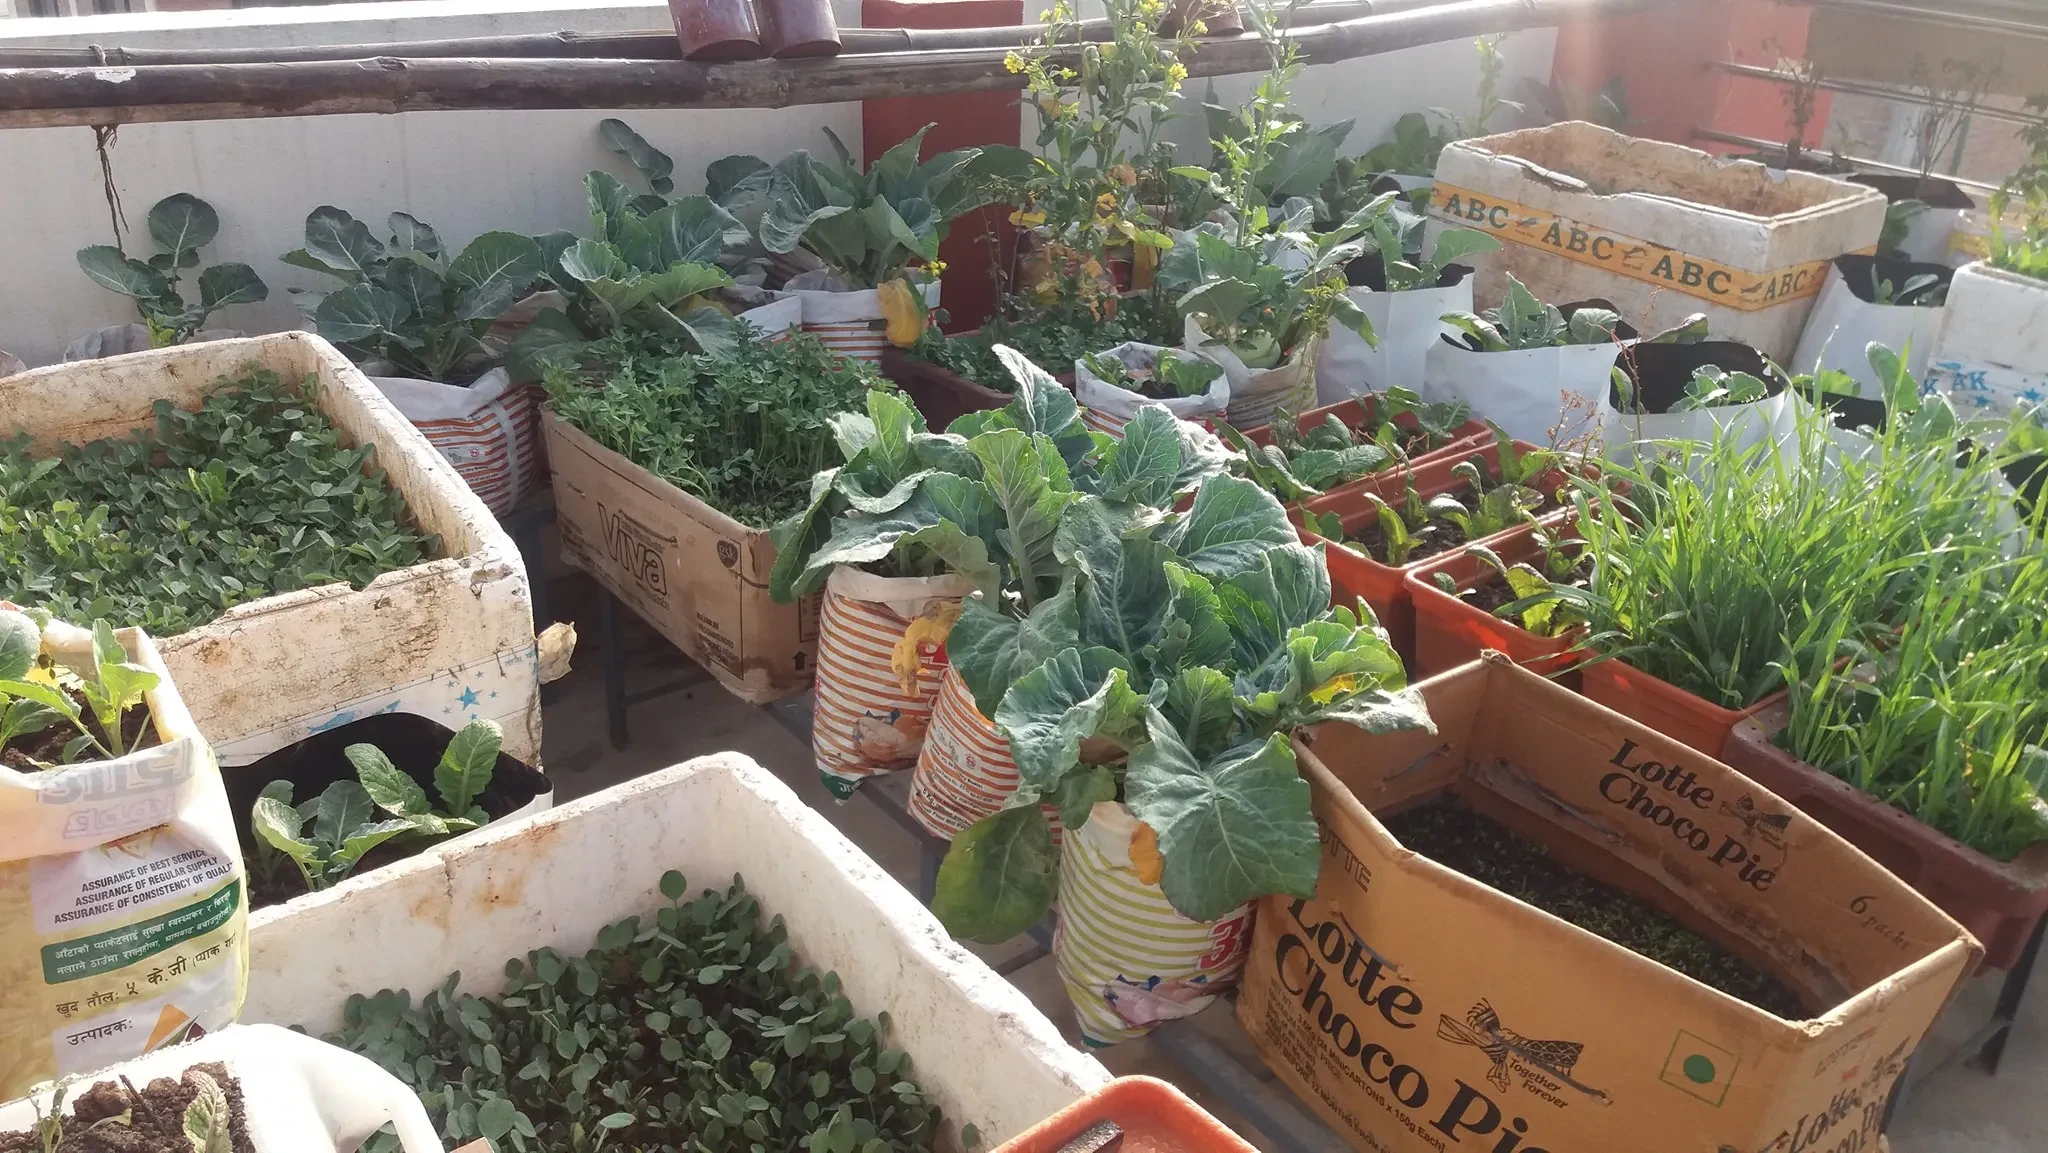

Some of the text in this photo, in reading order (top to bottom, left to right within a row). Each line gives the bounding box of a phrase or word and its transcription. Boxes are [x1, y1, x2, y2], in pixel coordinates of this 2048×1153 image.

[1443, 193, 1808, 301] ABC ABC ABC ABC
[1609, 738, 1714, 809] Lotte
[1599, 772, 1776, 891] Choco Pie
[75, 857, 218, 906] ASSURANCE OF REGULAR SUPPLY
[82, 869, 136, 893] ASSURANCE
[138, 865, 149, 876] OF
[150, 859, 172, 871] BEST
[54, 902, 115, 924] ASSURANCE
[117, 897, 130, 909] OF
[132, 879, 191, 905] CONSISTENCY
[193, 873, 204, 884] OF
[1850, 895, 1878, 915] 6
[1287, 899, 1424, 1029] Lotte
[56, 1000, 80, 1018] खुद
[66, 1017, 134, 1047] उत्पादक:
[1276, 933, 1429, 1108] Choco
[1428, 1077, 1550, 1153] Pi
[1509, 1058, 1562, 1092] Together
[1522, 1079, 1568, 1108] Forever
[1394, 1108, 1417, 1134] 150g
